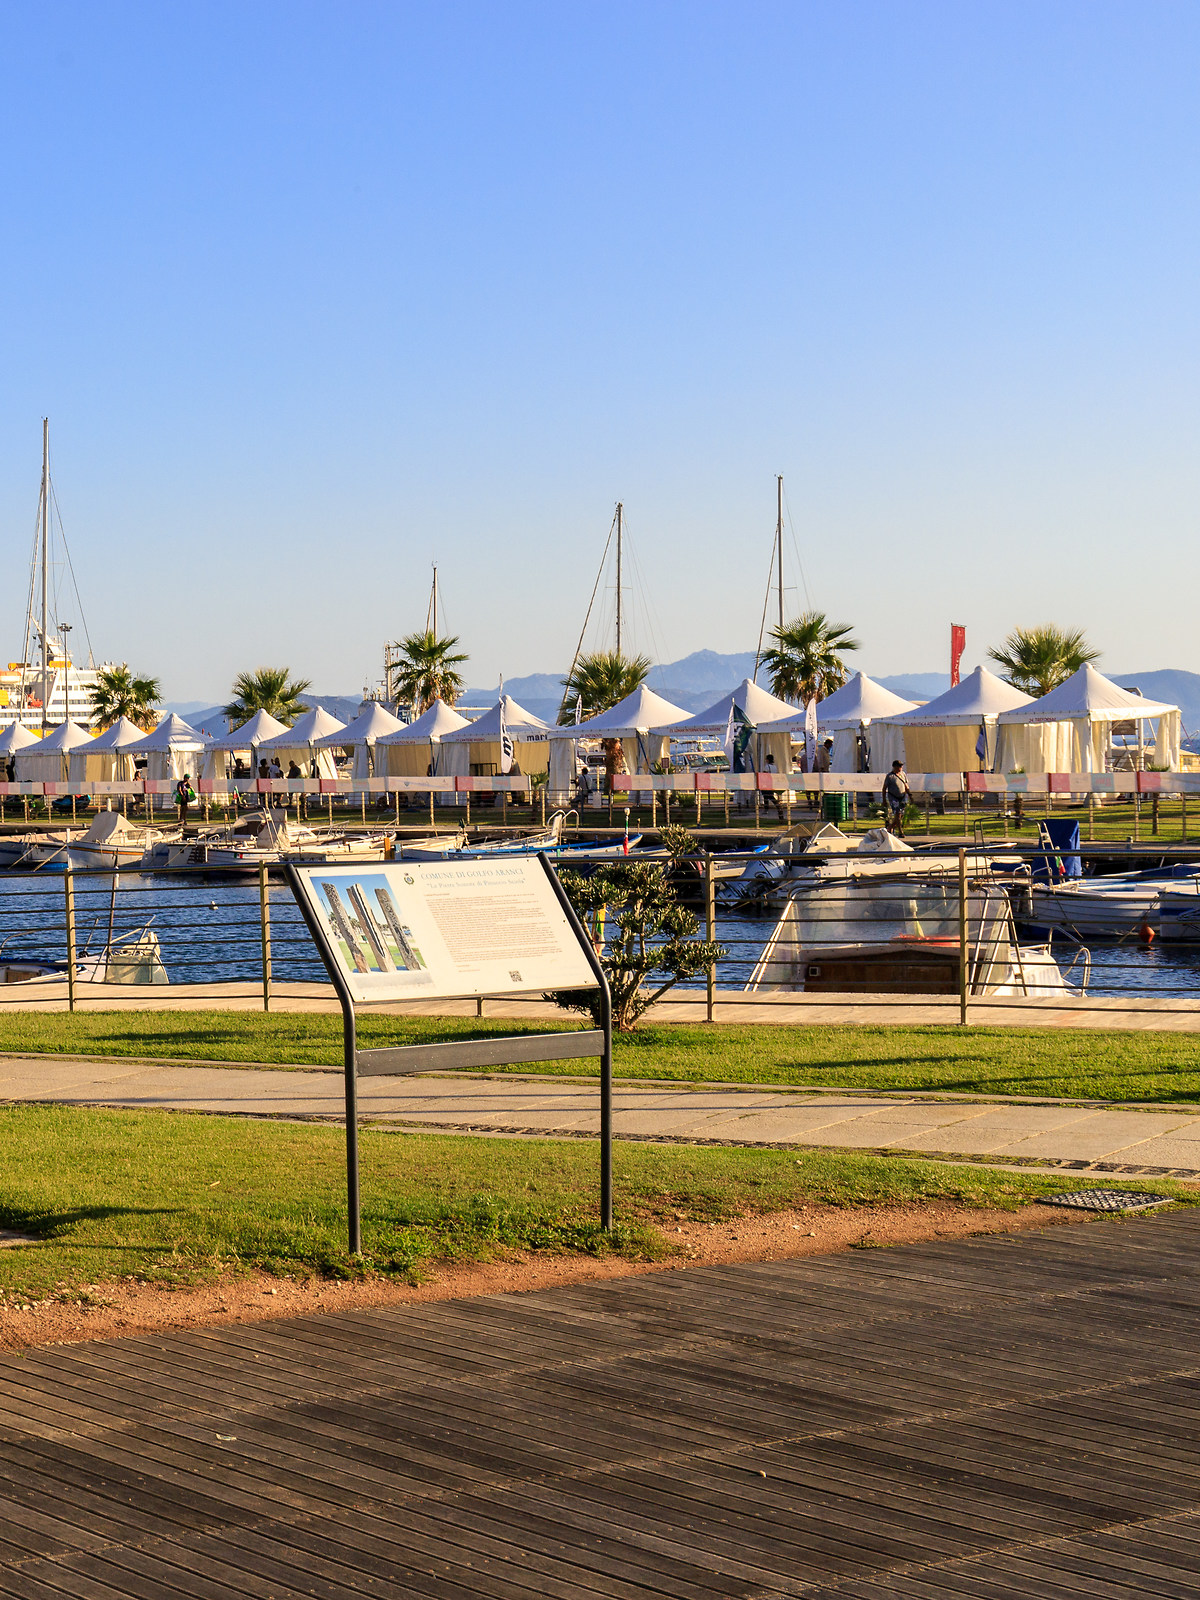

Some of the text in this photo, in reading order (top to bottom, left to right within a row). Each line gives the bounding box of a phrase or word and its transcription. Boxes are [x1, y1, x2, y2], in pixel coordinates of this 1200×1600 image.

[420, 872, 454, 880] COMUNE
[466, 870, 494, 878] GOLFO
[495, 868, 524, 876] ARANCI
